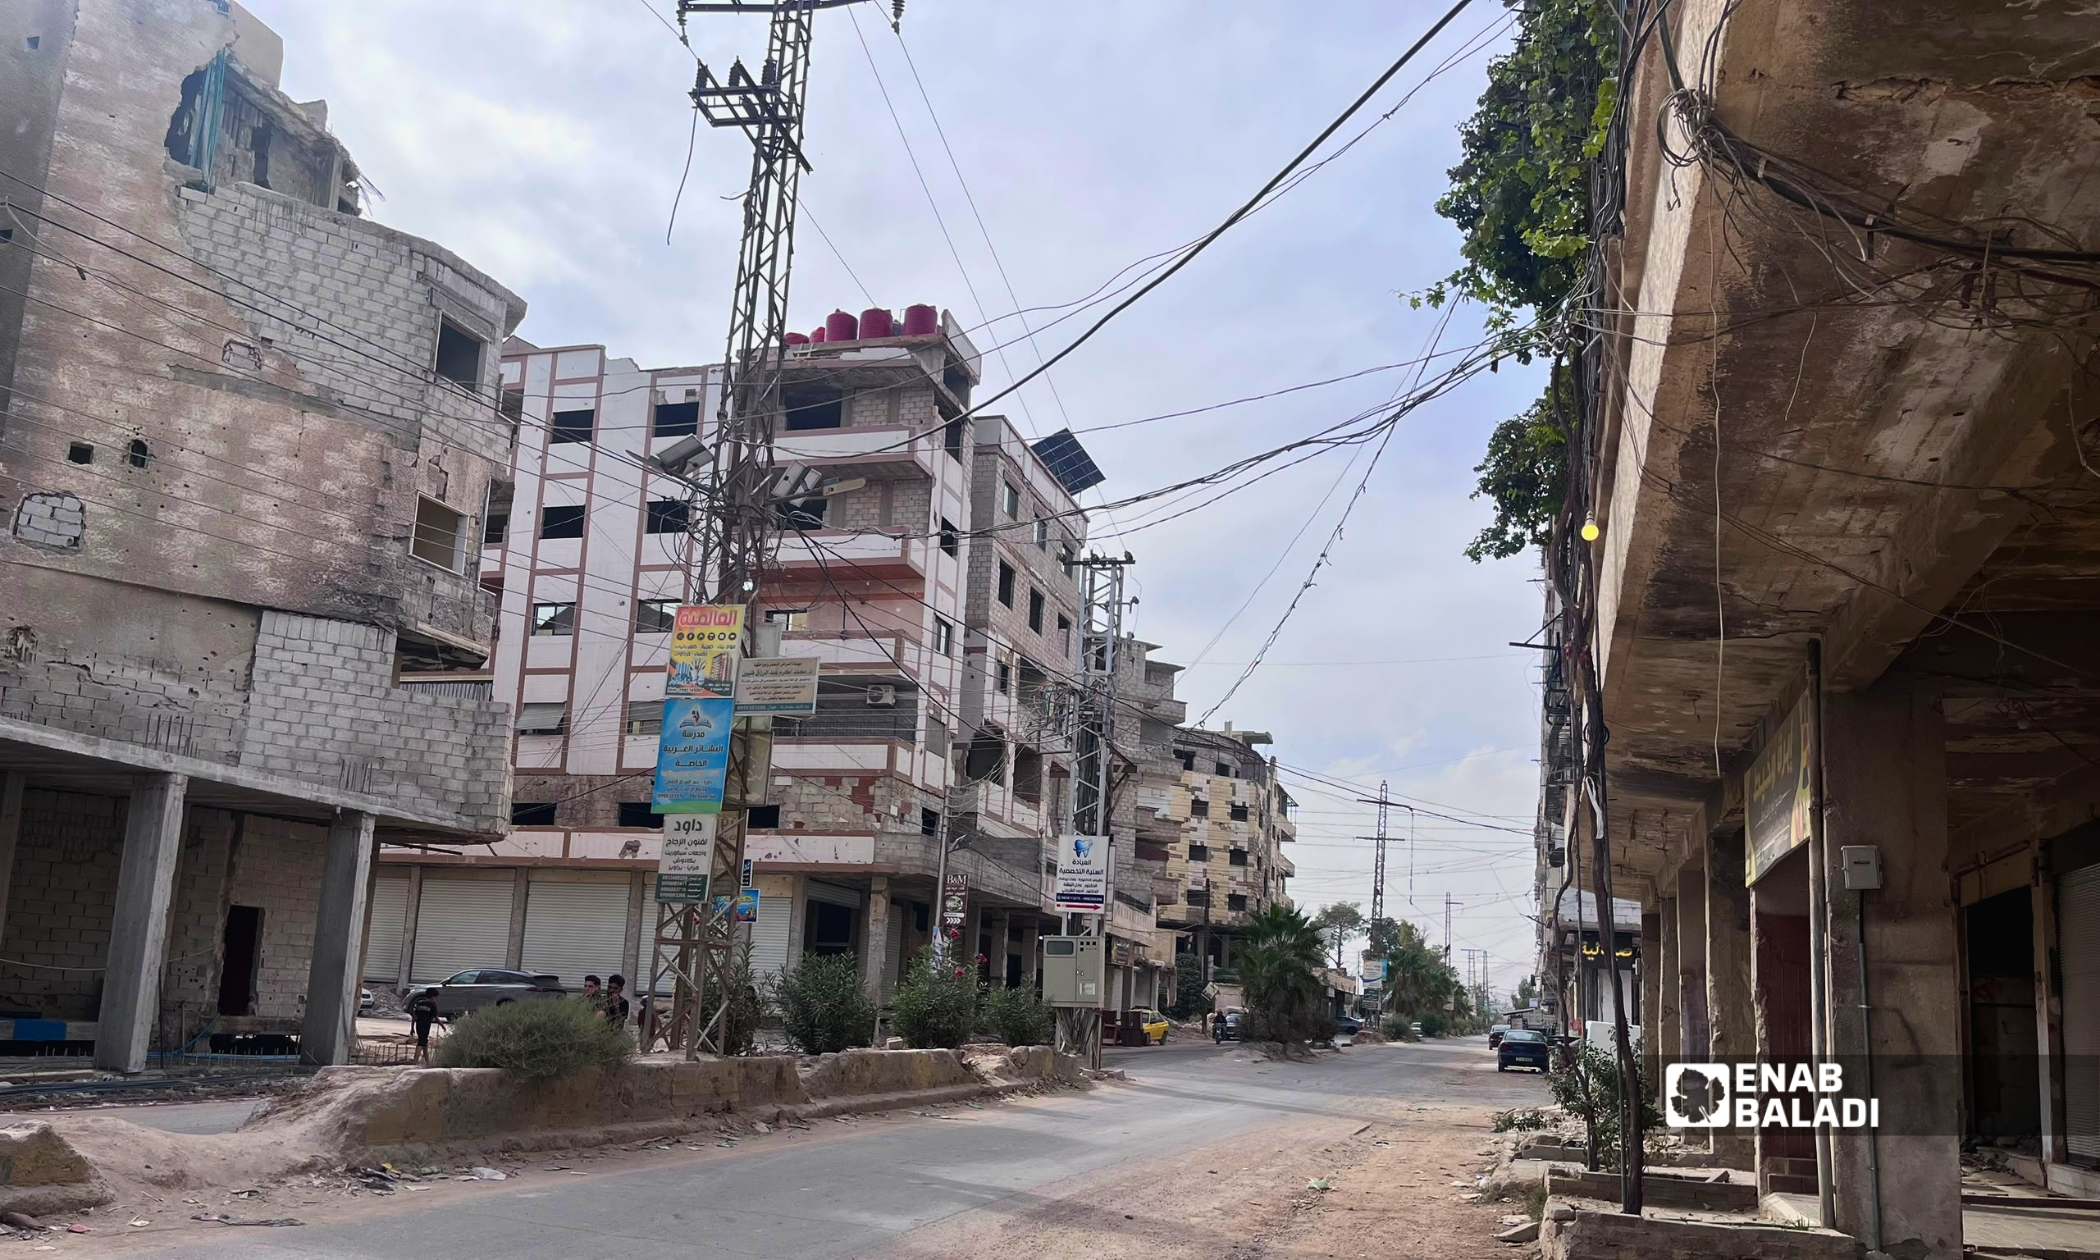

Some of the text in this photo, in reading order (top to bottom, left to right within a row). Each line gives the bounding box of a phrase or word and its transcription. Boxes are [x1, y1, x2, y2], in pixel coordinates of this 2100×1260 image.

[679, 609, 738, 631] العالمية
[682, 730, 705, 739] مدرسة
[674, 818, 703, 835] داود
[666, 839, 707, 847] لفنون الزجاج
[947, 875, 967, 884] B&M
